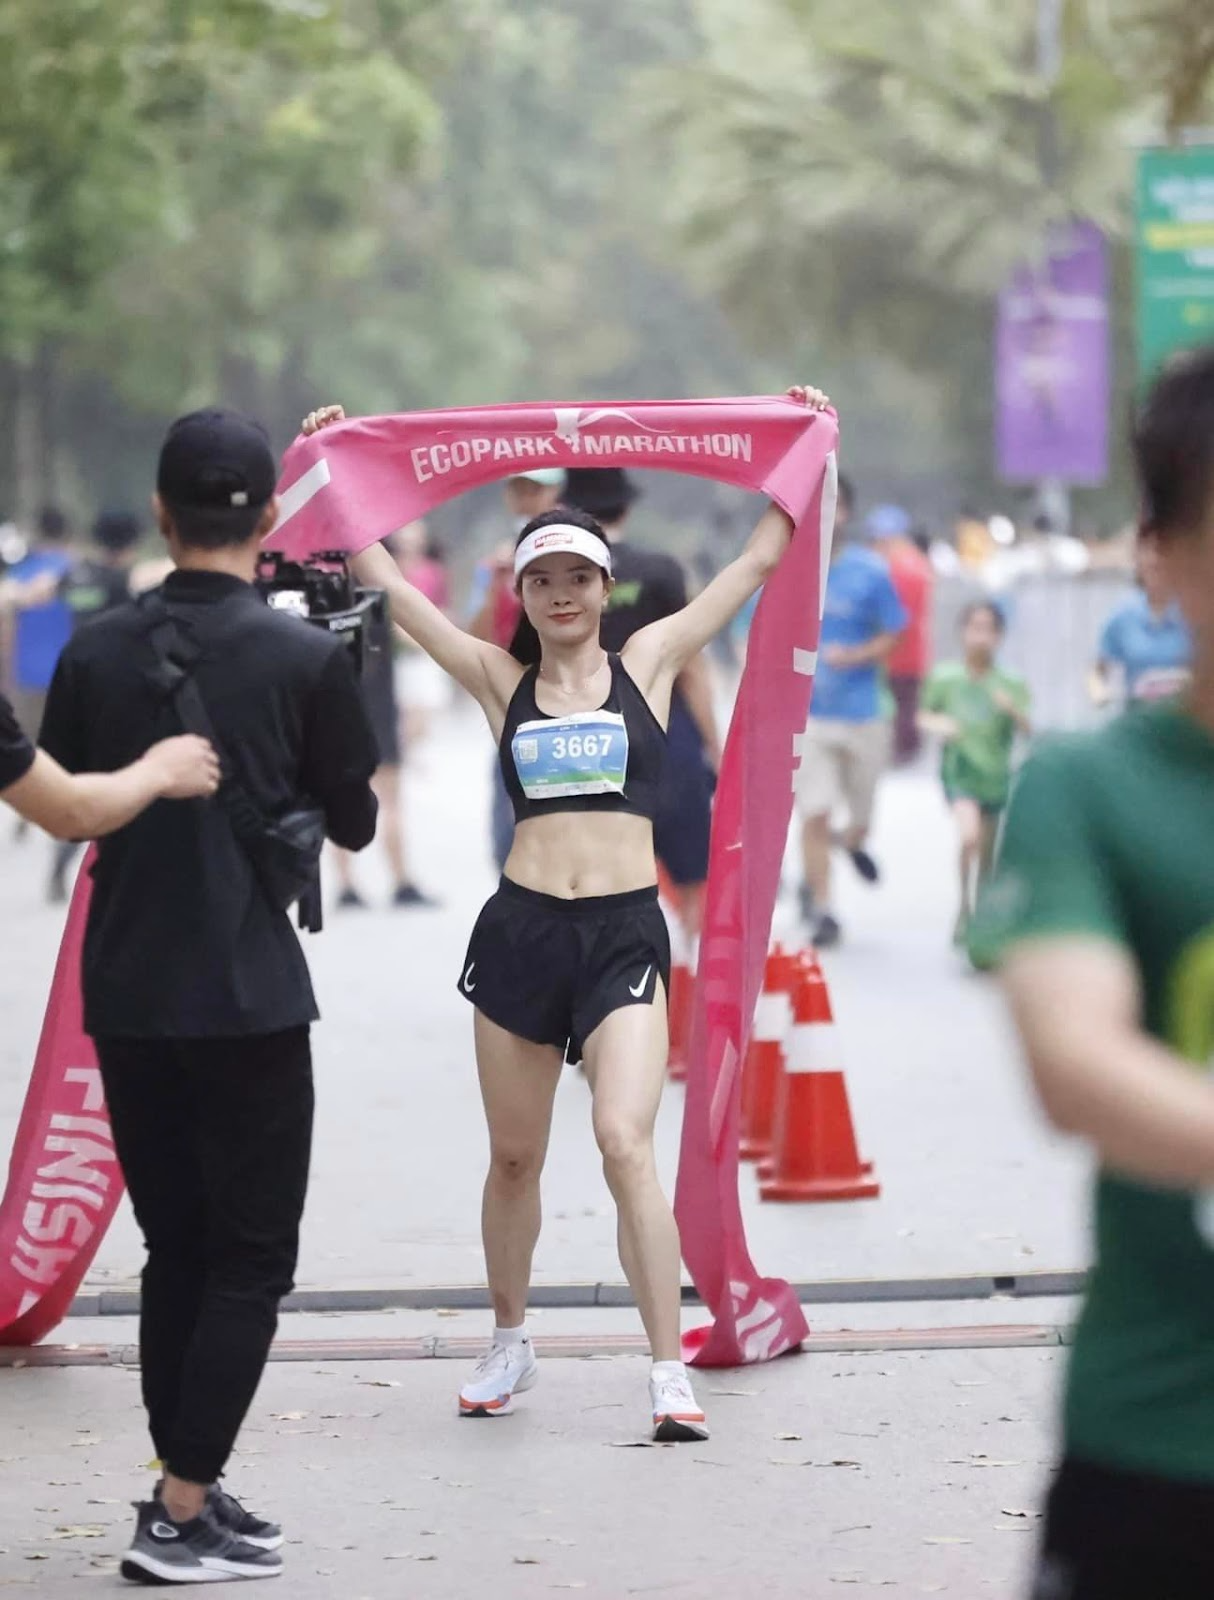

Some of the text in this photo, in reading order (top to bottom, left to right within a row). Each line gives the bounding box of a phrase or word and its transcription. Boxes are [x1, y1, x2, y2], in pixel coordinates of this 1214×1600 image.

[410, 433, 752, 483] ECOPARK MARATHON
[552, 734, 613, 759] 3667
